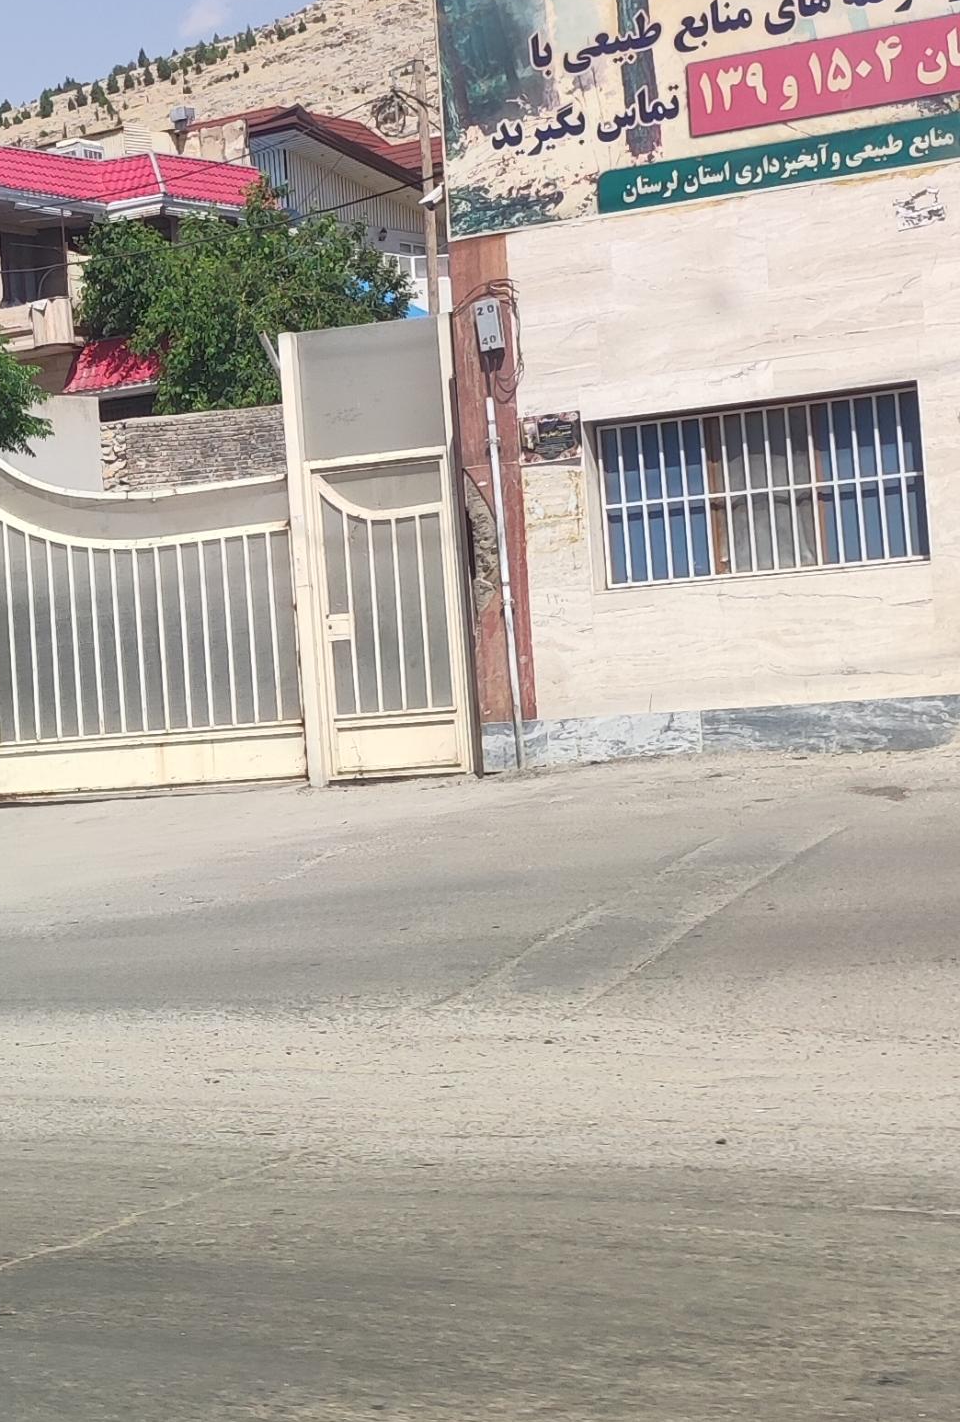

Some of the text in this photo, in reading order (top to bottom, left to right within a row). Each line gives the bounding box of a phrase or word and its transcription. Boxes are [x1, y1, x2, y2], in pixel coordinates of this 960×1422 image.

[529, 33, 553, 73] با
[562, 12, 662, 75] طبیعی
[807, 35, 902, 98] ۱۵۰۴
[698, 61, 768, 115] ۱۳۹
[779, 74, 799, 112] و
[491, 104, 586, 157] بگیرید
[596, 83, 680, 138] تماس
[845, 134, 903, 168] طبیعی
[909, 127, 954, 157] منابع
[683, 161, 730, 193] استان
[735, 143, 828, 186] آبخیزداری
[622, 169, 679, 204] لرستان
